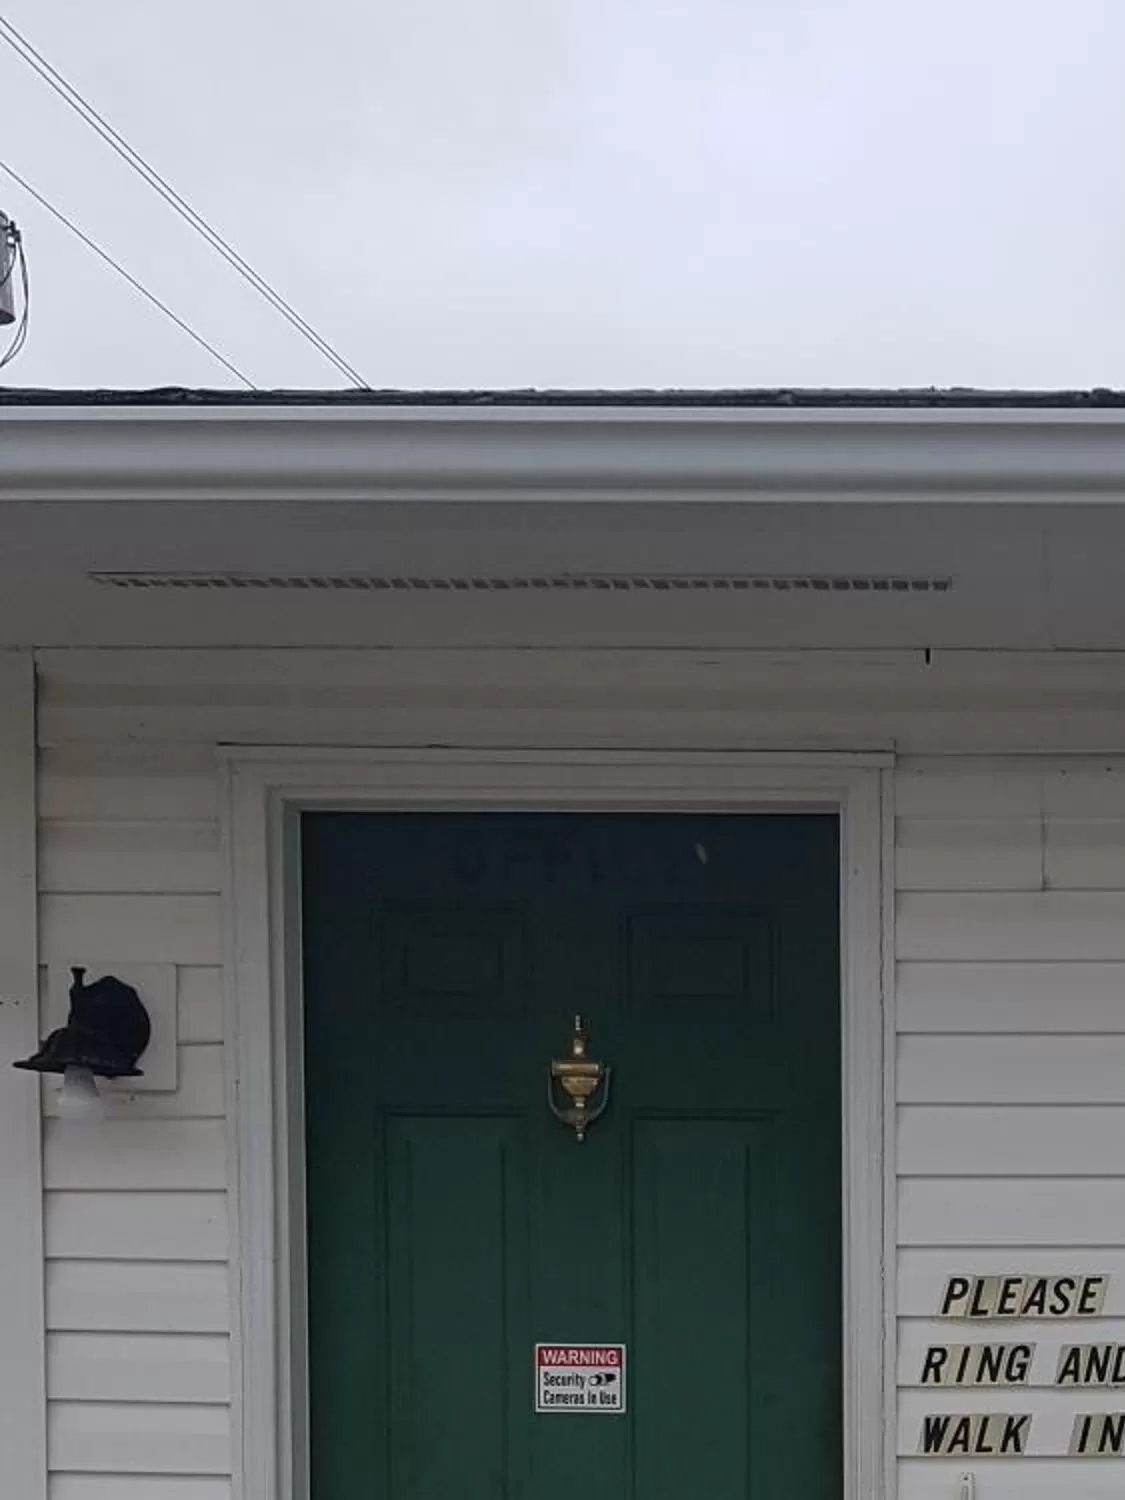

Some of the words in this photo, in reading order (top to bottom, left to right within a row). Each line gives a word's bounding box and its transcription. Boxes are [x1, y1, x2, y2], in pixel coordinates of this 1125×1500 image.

[941, 1276, 1103, 1317] PLEASE
[541, 1349, 619, 1365] WARNING
[920, 1344, 1032, 1384] RING
[543, 1371, 586, 1389] Security
[543, 1389, 585, 1405] Cameras
[587, 1390, 598, 1405] In
[600, 1390, 617, 1405] Use
[922, 1415, 1029, 1453] WALK
